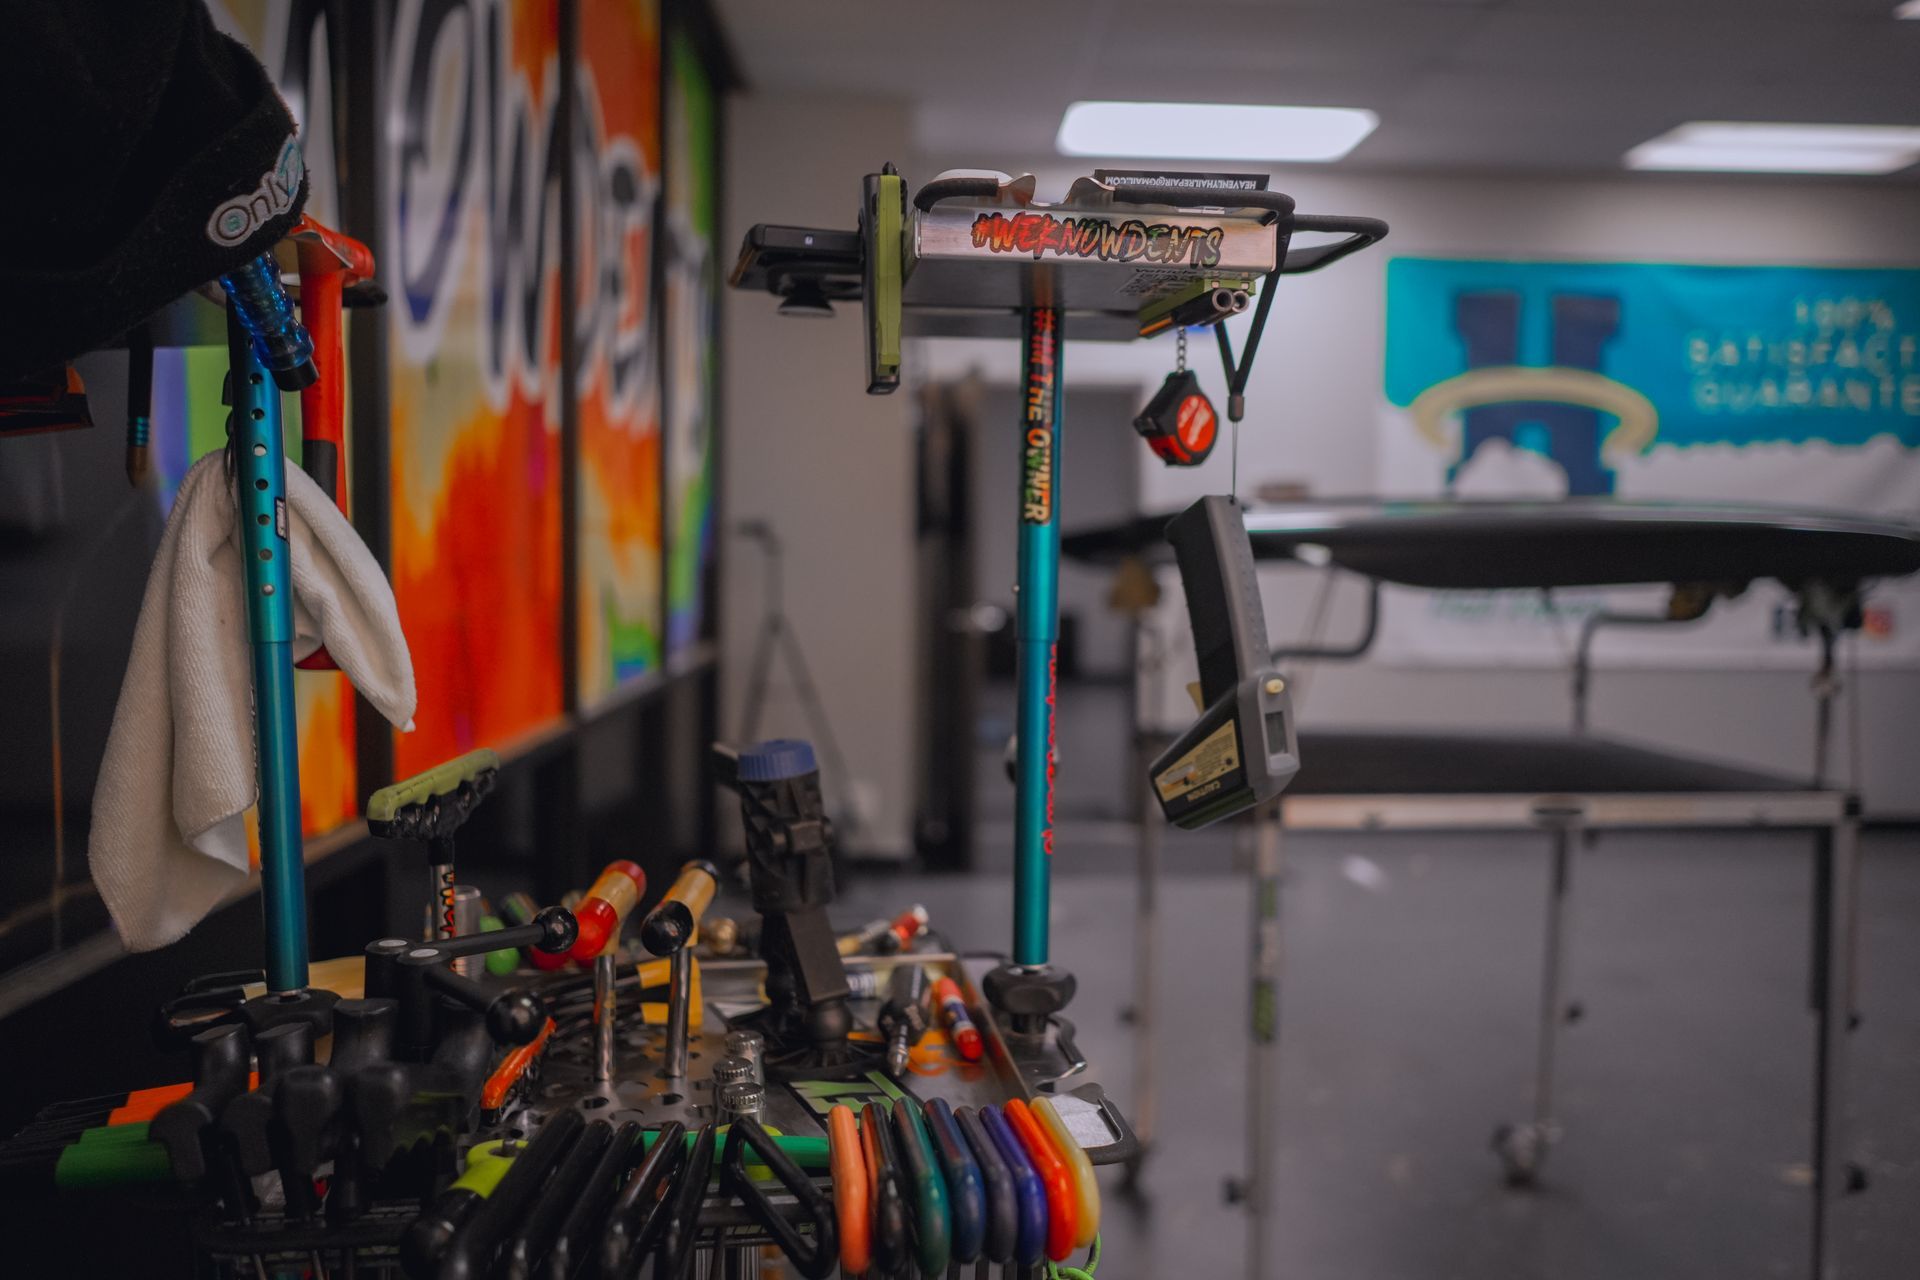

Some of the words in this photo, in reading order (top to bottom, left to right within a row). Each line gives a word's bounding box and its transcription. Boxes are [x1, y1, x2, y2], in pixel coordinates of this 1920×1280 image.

[1104, 176, 1257, 189] HEAVENLYHAILREPAIR@GMAIL.COM
[971, 211, 1224, 268] #WEKNOWDENTS
[1024, 427, 1052, 520] OWNER
